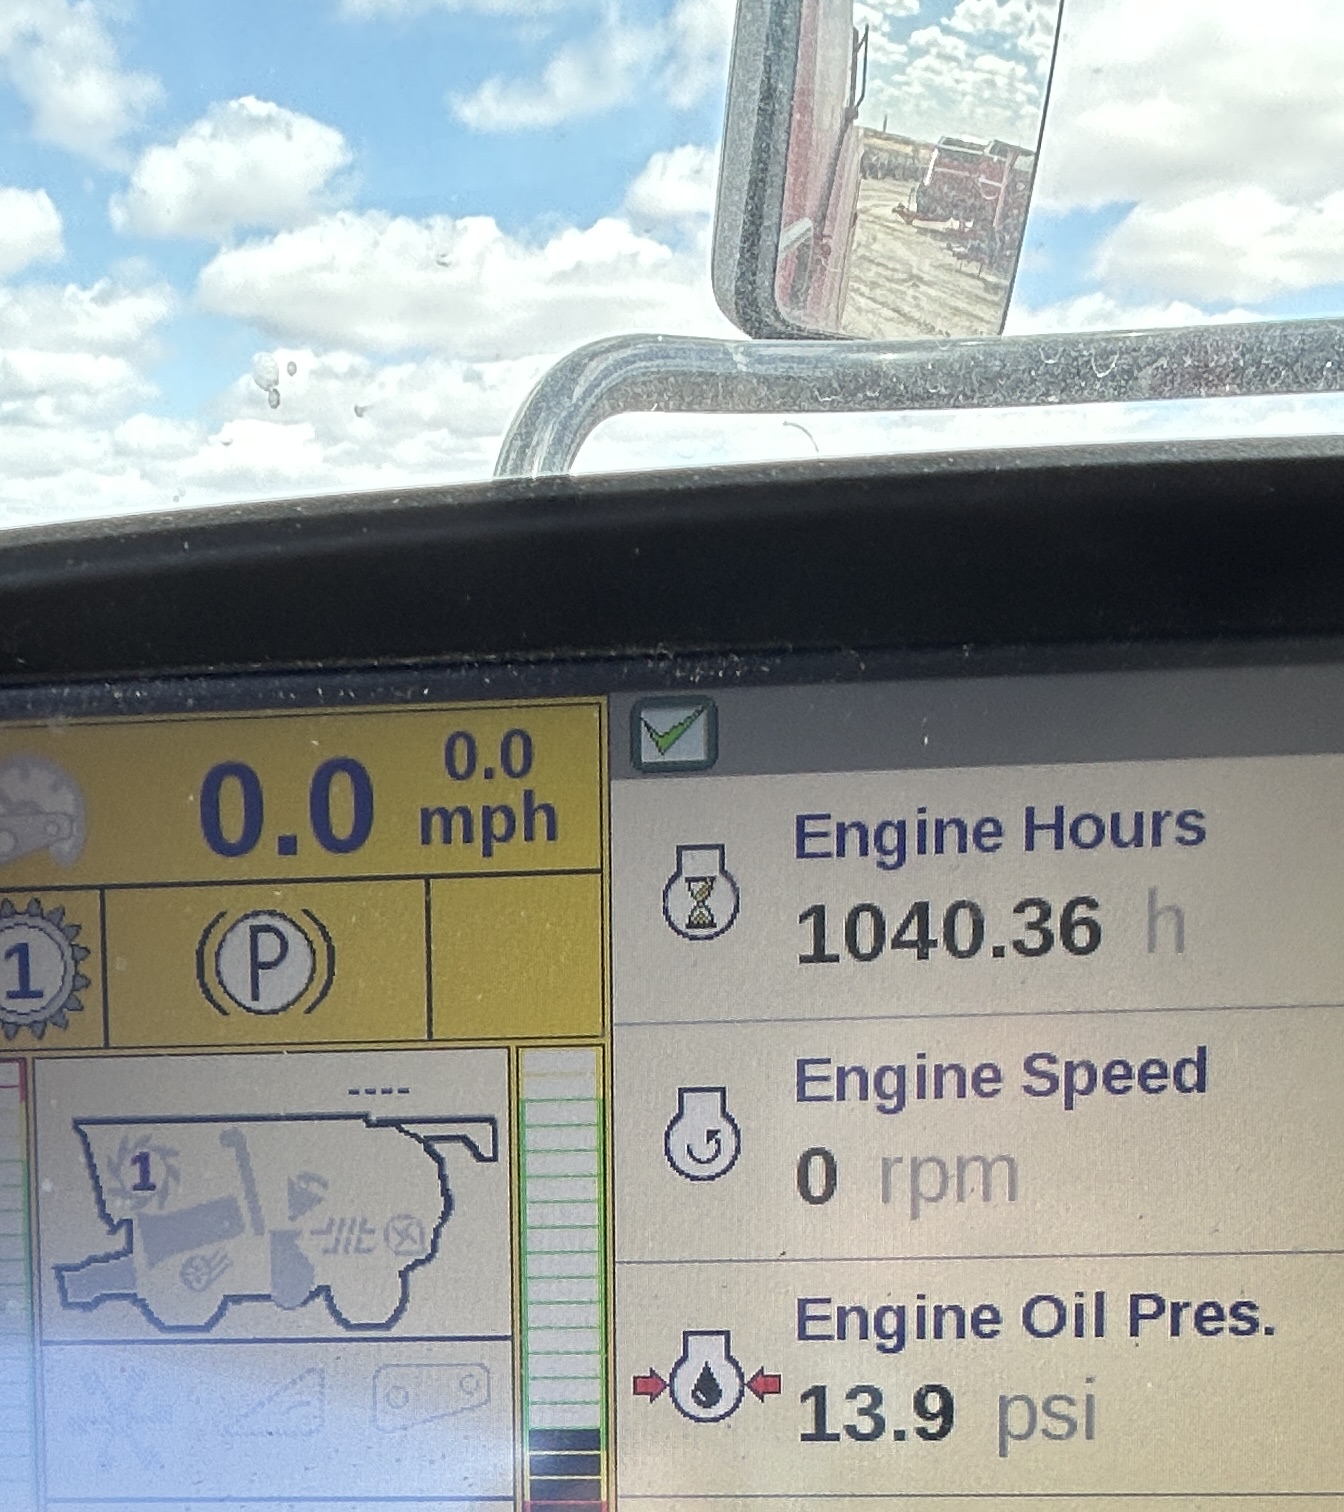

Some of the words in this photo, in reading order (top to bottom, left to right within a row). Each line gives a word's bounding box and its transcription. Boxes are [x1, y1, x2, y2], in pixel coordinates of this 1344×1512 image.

[444, 729, 534, 781] 0.0
[200, 757, 375, 857] 0.0
[421, 790, 557, 857] mph
[795, 807, 1004, 871] Engine
[1024, 804, 1207, 852] Hours
[797, 896, 1101, 965] 1040.36
[1147, 886, 1185, 954] h
[4, 942, 44, 999] 1
[249, 925, 288, 1001] P
[795, 1052, 1003, 1114] Engine
[1023, 1045, 1208, 1110] Speed
[131, 1151, 155, 1191] 1
[797, 1146, 838, 1205] 0
[880, 1150, 1017, 1220] rpm
[797, 1294, 1002, 1354] Engine
[1023, 1291, 1105, 1340] Oil
[1129, 1293, 1275, 1338] Pres.
[799, 1384, 954, 1441] 13.9
[998, 1376, 1096, 1457] psi
